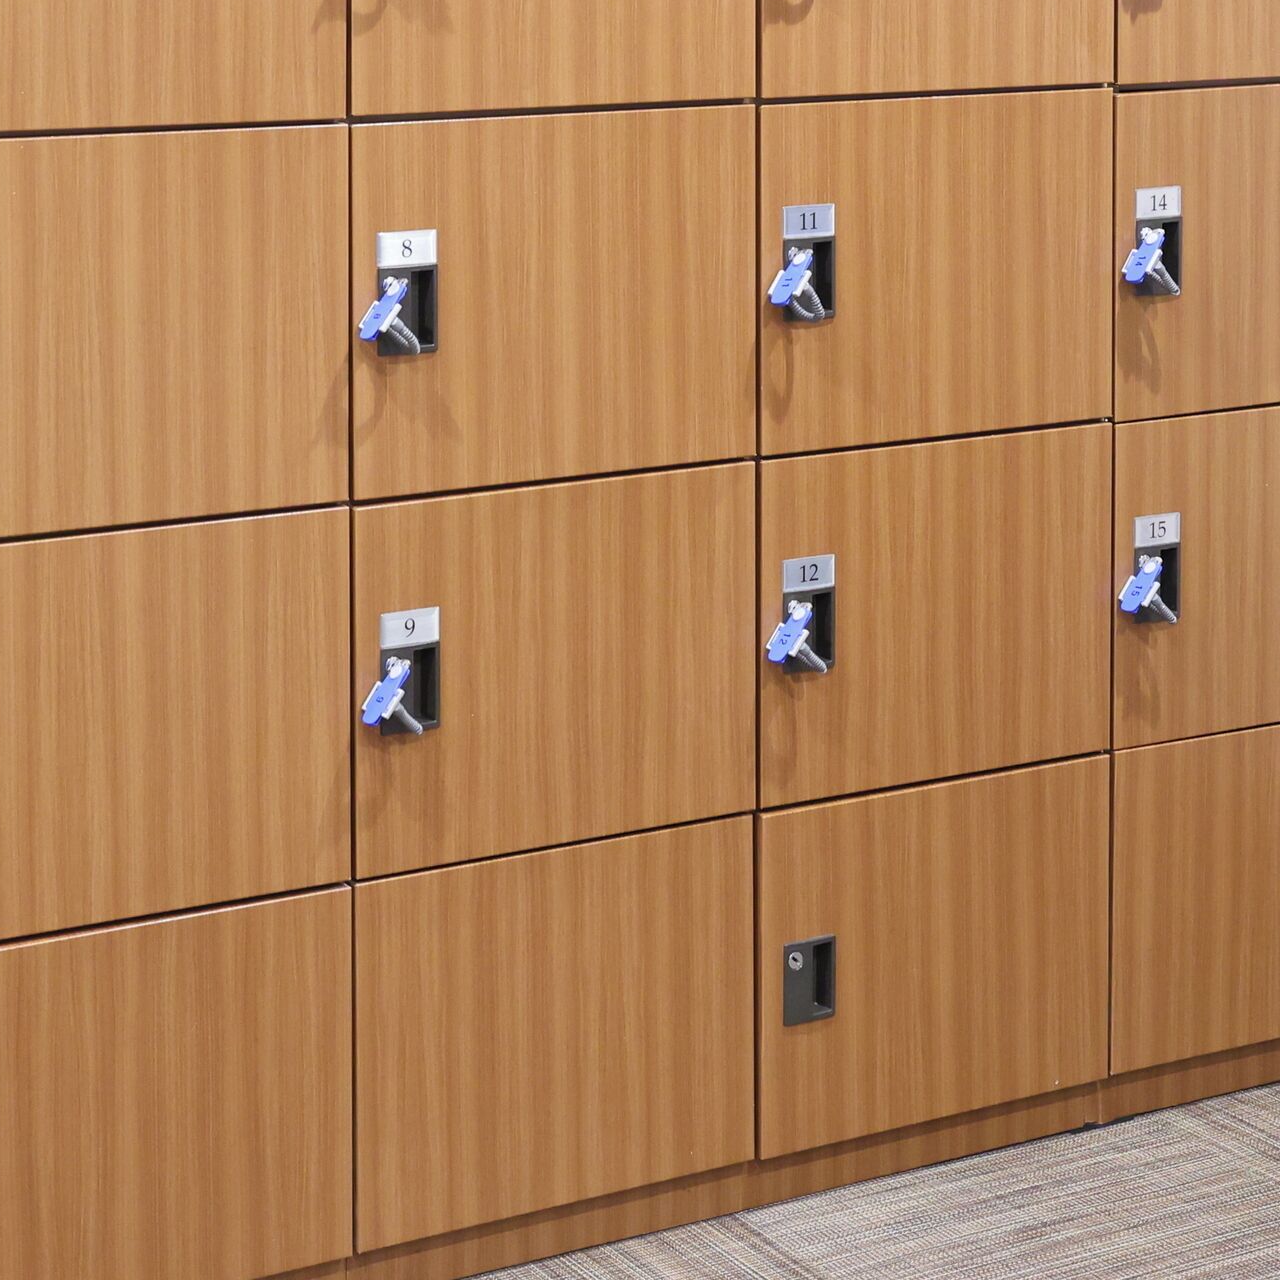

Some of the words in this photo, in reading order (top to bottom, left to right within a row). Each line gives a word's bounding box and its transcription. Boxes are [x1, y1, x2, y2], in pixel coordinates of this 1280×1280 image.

[1152, 194, 1167, 211] 14
[800, 212, 817, 230] 11
[402, 240, 413, 257] 8
[1150, 521, 1166, 539] 15
[800, 563, 819, 583] 12
[404, 618, 415, 637] 9
